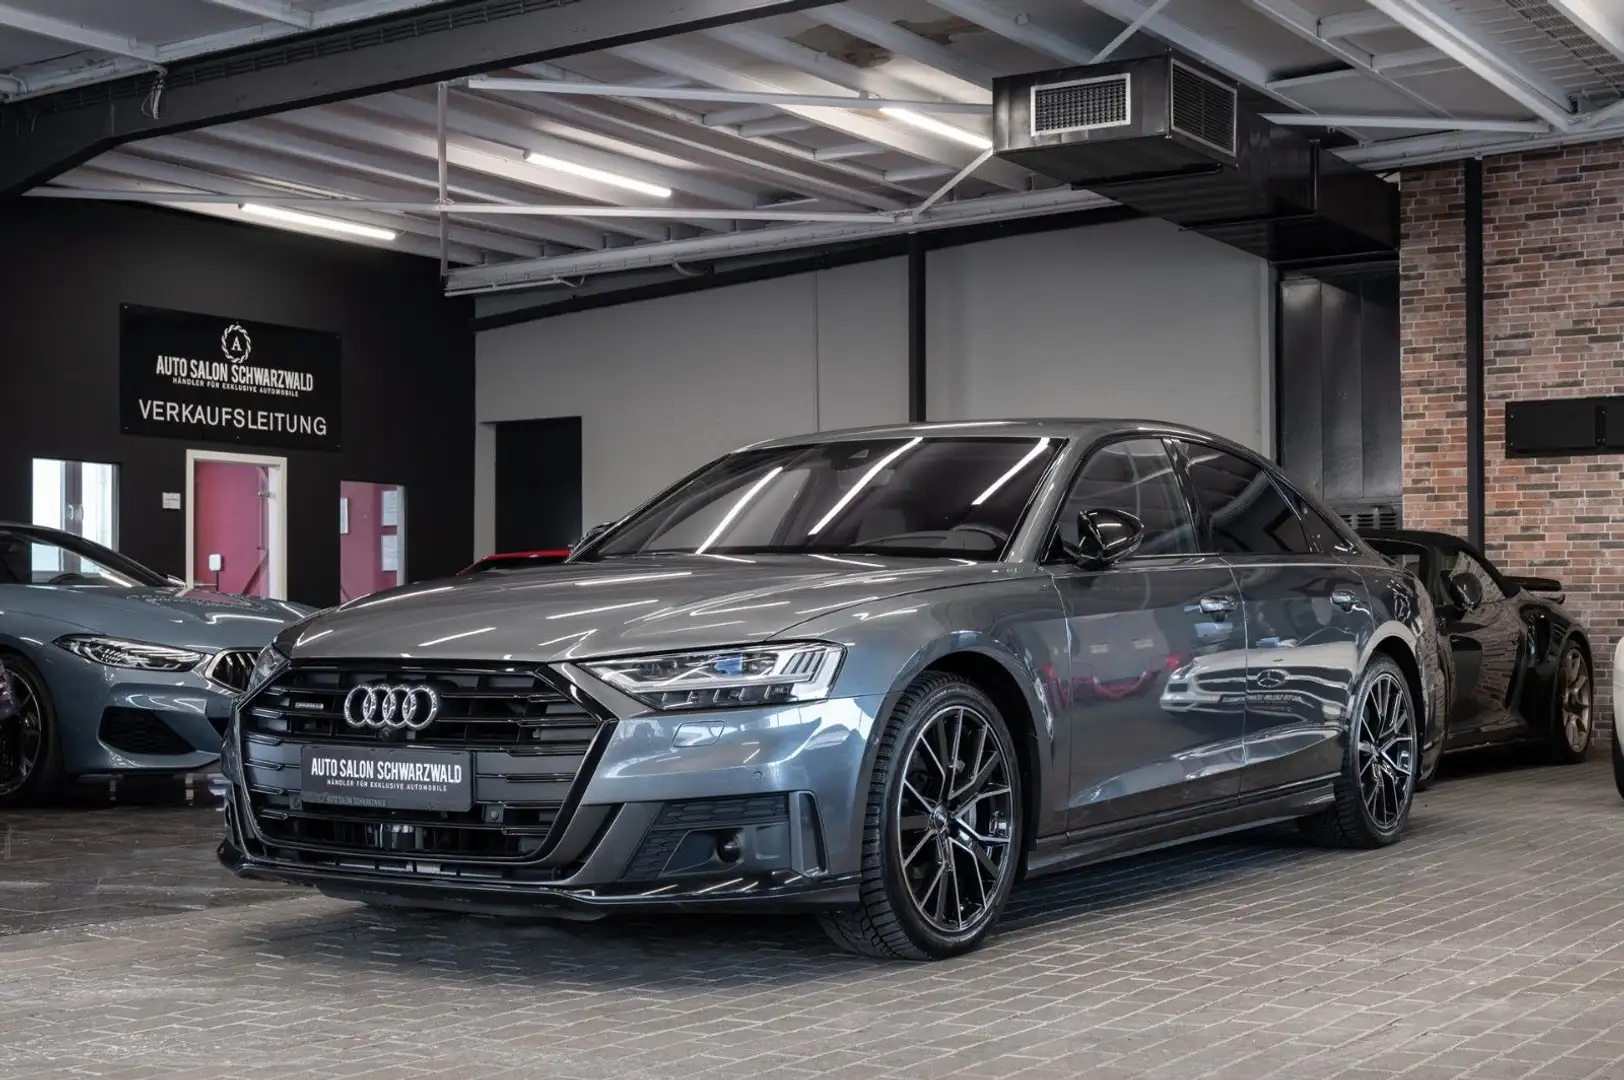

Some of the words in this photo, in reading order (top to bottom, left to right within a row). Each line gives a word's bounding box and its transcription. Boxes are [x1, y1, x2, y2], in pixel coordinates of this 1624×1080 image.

[156, 355, 188, 377] AUTO
[190, 359, 228, 382] SALON
[231, 364, 314, 392] SCHWARZWALD
[222, 382, 257, 393] EXKLUSIVE
[259, 386, 299, 397] AUTOMOBILE
[138, 399, 327, 435] VERKAUFSLEITUNG
[311, 757, 338, 777] AUTO
[339, 758, 374, 779] SALON
[377, 761, 462, 783] SCHWARZWALD
[370, 781, 404, 790] EXKLUSIVE
[406, 783, 447, 792] AUTOMOBILE
